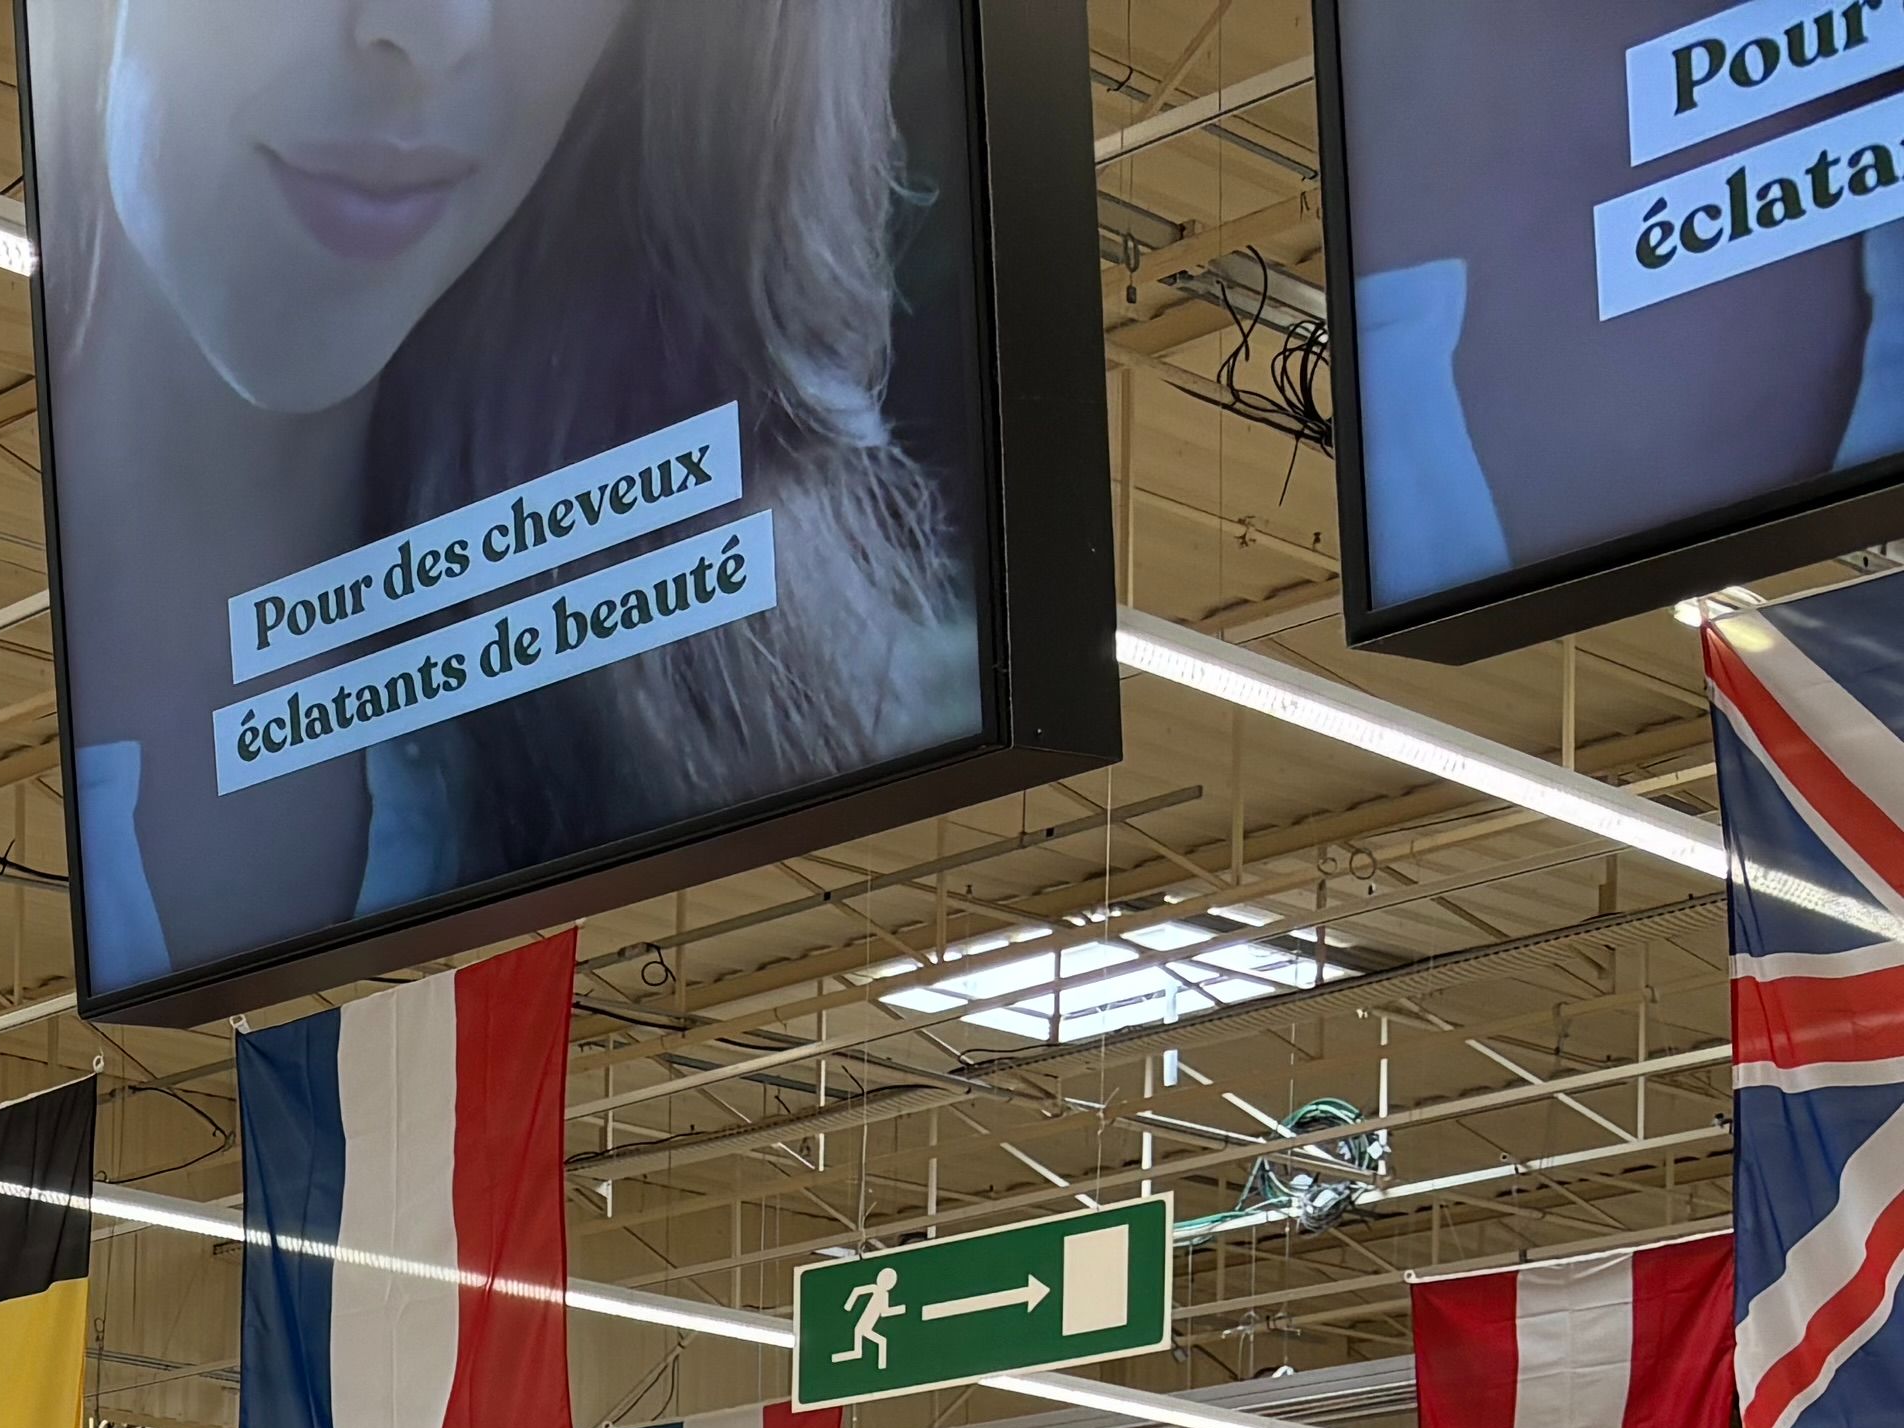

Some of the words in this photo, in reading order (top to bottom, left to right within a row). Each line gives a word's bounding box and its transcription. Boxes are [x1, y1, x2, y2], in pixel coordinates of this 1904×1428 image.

[1672, 0, 1883, 117] Pour
[1635, 141, 1904, 270] éclata
[253, 573, 375, 650] Pour
[383, 539, 471, 599] des
[481, 443, 713, 564] cheveux
[236, 651, 468, 761] éclatants
[479, 617, 542, 678] de
[553, 533, 748, 655] beauté
